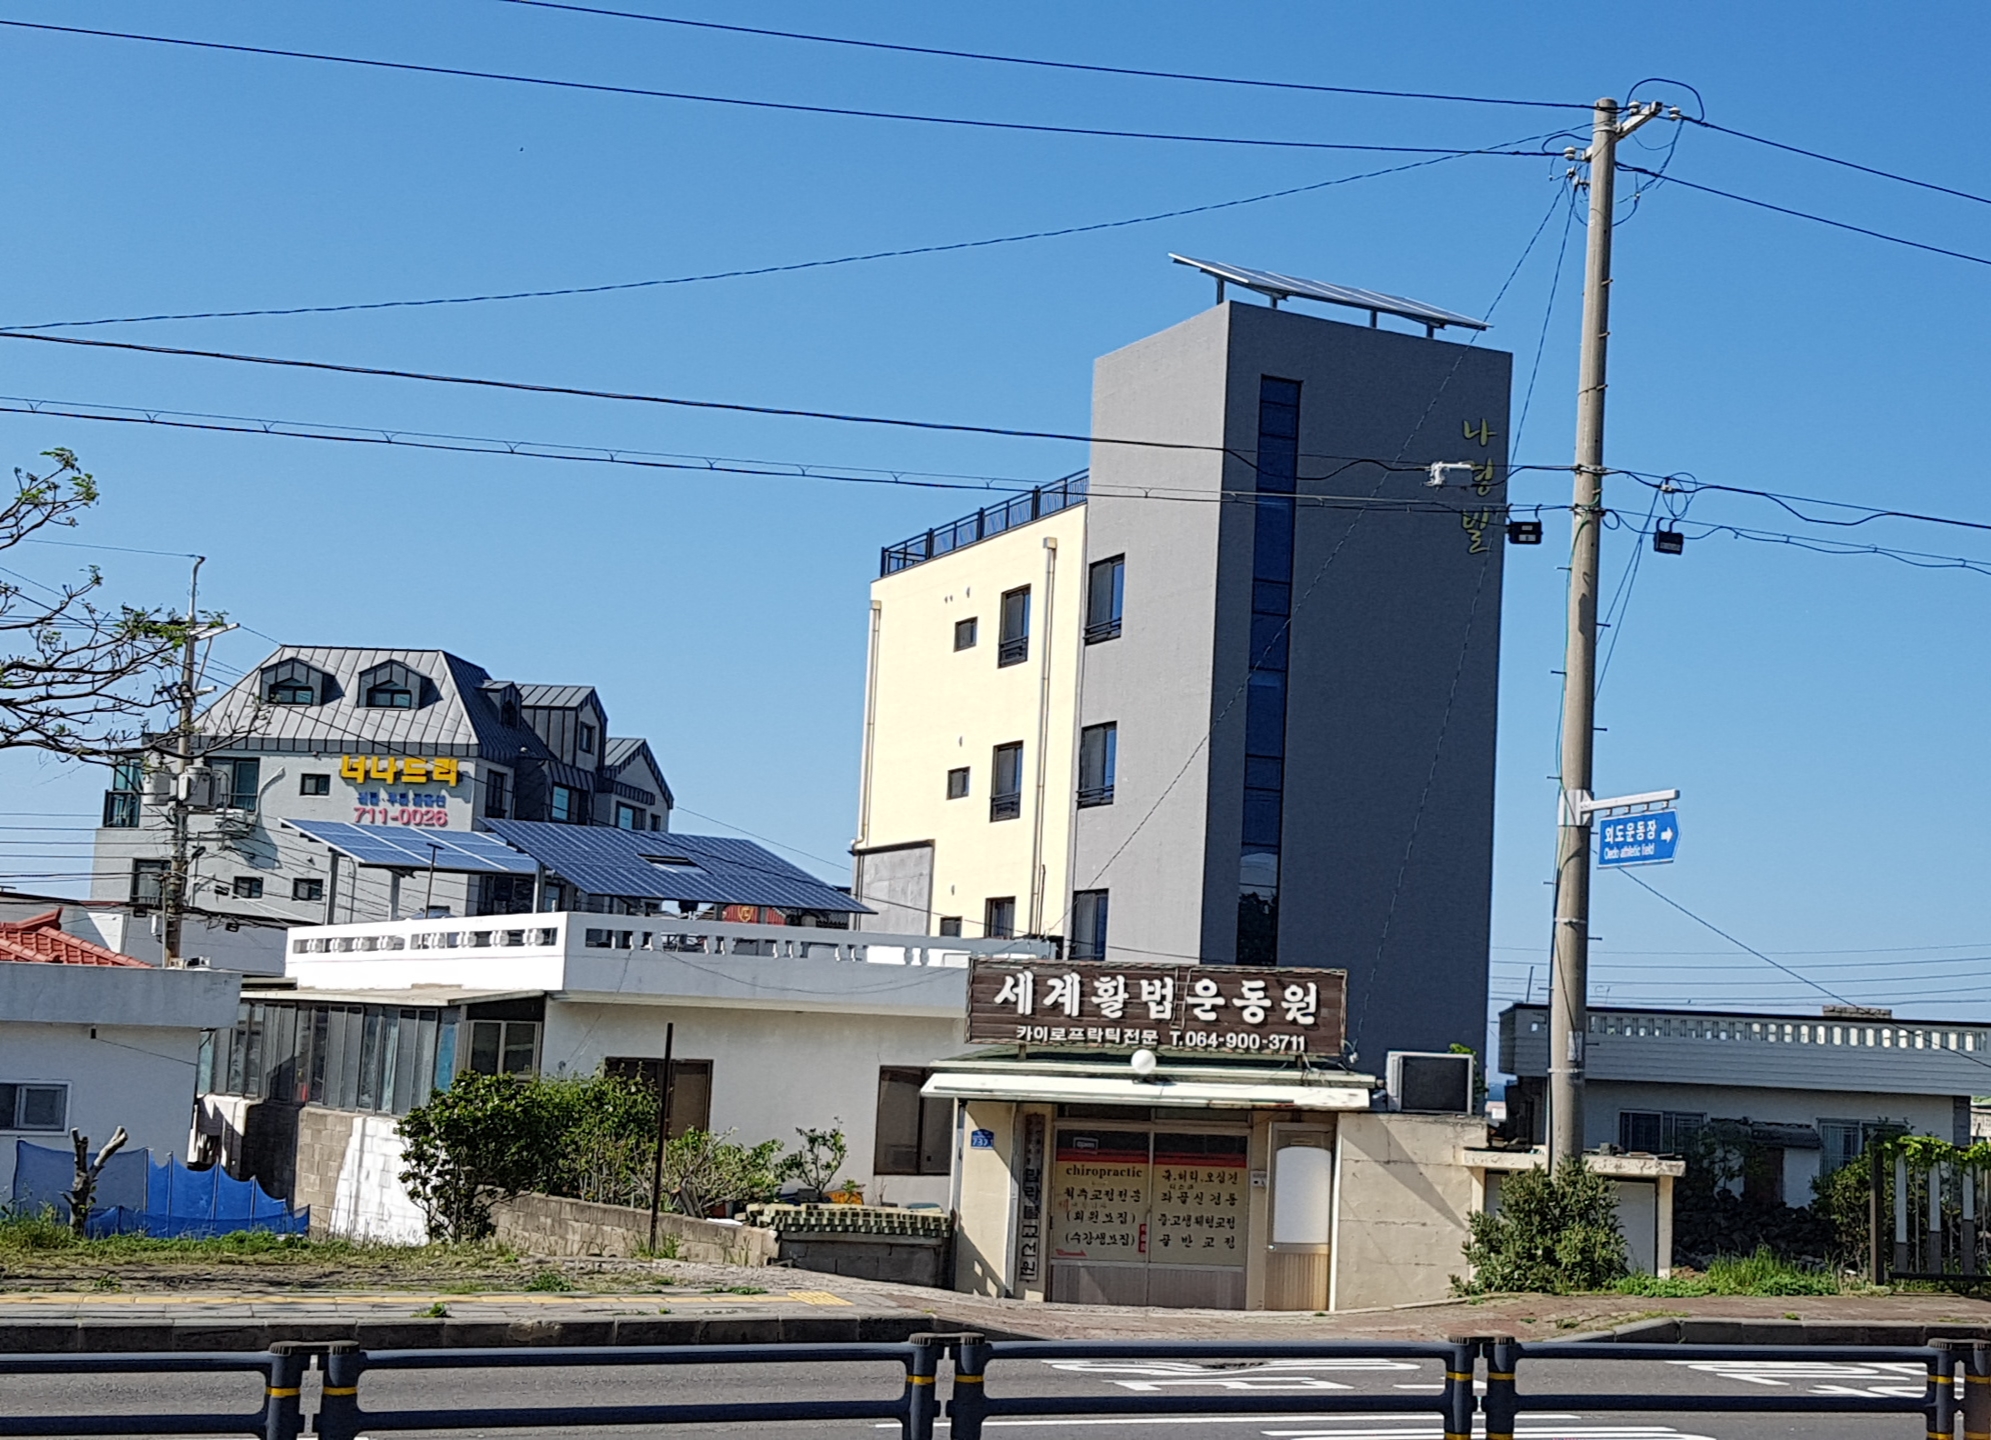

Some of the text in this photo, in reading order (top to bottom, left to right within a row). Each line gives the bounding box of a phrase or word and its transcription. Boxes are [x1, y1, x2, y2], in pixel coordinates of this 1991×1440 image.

[340, 755, 459, 787] 너나드리
[353, 807, 448, 826] 711-0026
[1605, 820, 1656, 844] 외도운동장
[994, 970, 1318, 1025] 세계활법운동원
[1016, 1025, 1159, 1046] 카이로프락틱전문
[1065, 1164, 1143, 1179] chiropractic
